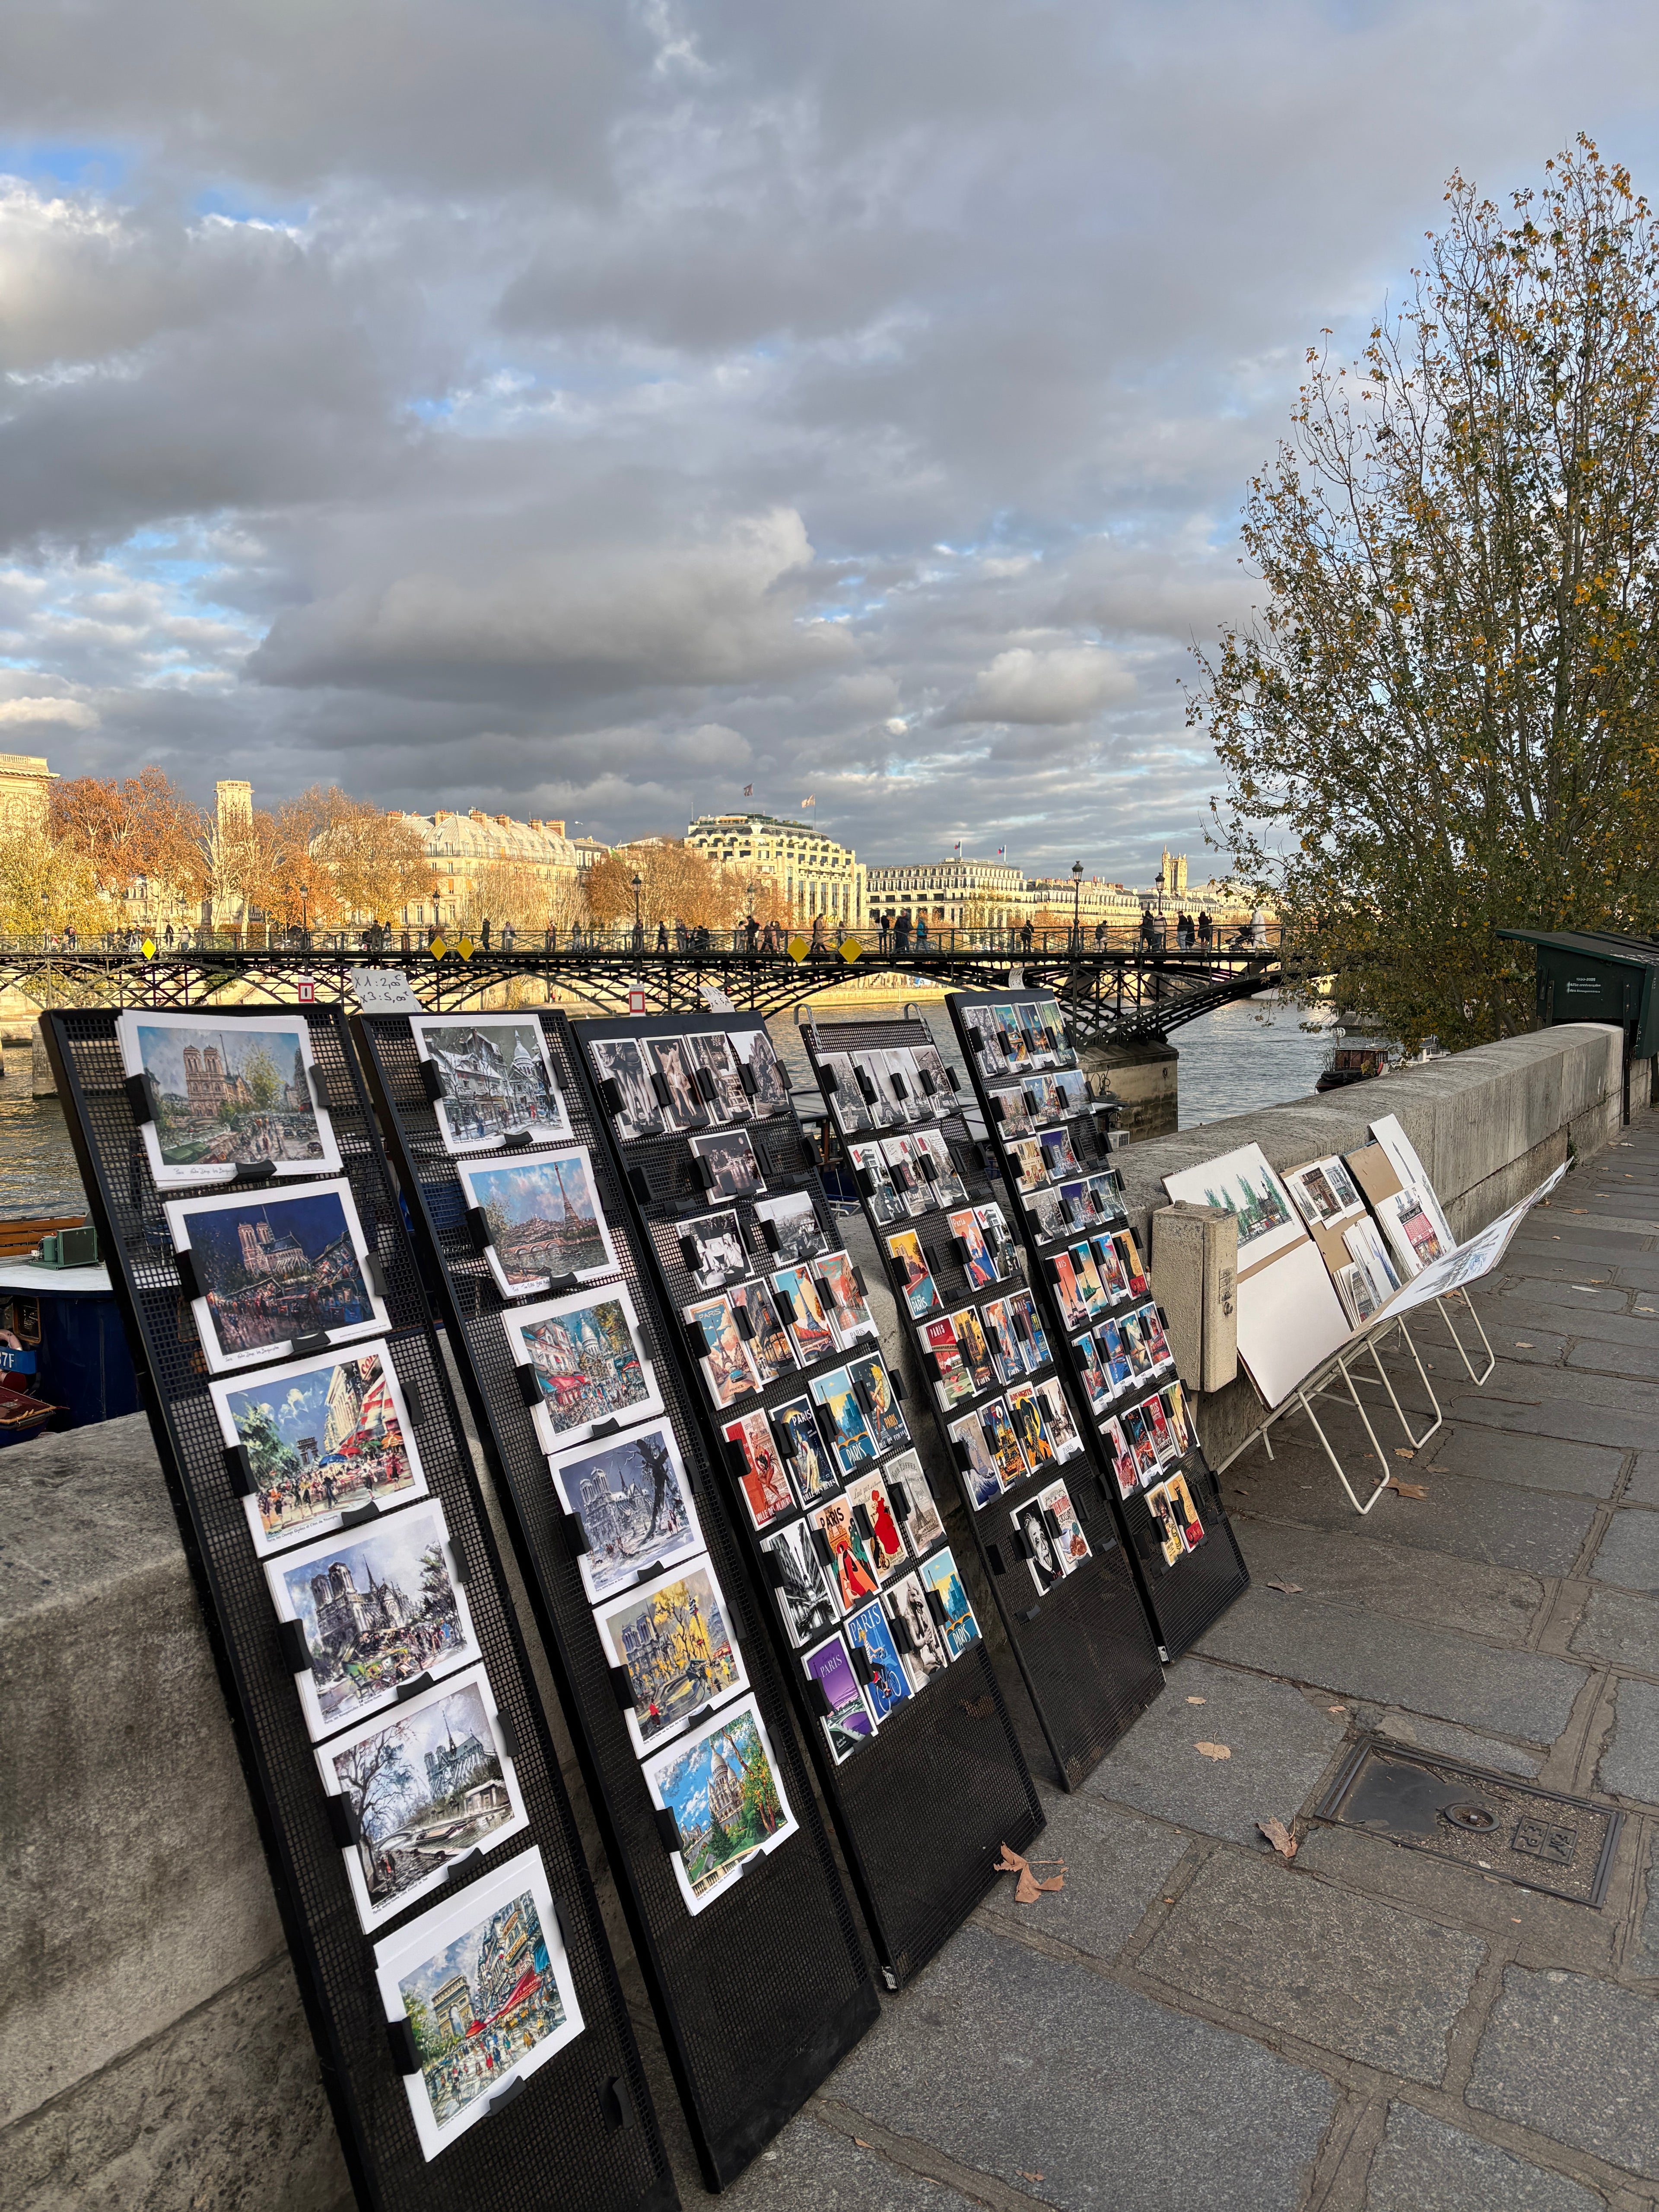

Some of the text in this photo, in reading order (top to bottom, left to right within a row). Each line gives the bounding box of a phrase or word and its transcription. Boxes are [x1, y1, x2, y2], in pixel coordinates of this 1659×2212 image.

[952, 1217, 966, 1227] Paris
[1055, 1259, 1067, 1270] ARIS
[912, 1297, 928, 1313] PARIS
[699, 1308, 721, 1320] PARIS
[850, 1328, 865, 1339] PARIS
[930, 1324, 945, 1339] PARIS
[977, 1375, 990, 1386] Paris
[729, 1384, 744, 1392] FRANCE
[1150, 1402, 1160, 1415] RIS
[792, 1409, 812, 1426] PARIS
[884, 1413, 898, 1429] PARIS
[846, 1442, 867, 1467] PARIS
[1062, 1443, 1074, 1454] PARIS
[899, 1462, 917, 1471] EIFFEL
[803, 1493, 814, 1502] VILLE
[814, 1486, 823, 1496] DES
[756, 1509, 768, 1523] VILLE
[820, 1507, 844, 1530] PARIS
[850, 1605, 881, 1642] PARIS
[952, 1624, 971, 1651] PARIS
[820, 1654, 842, 1678] PARIS
